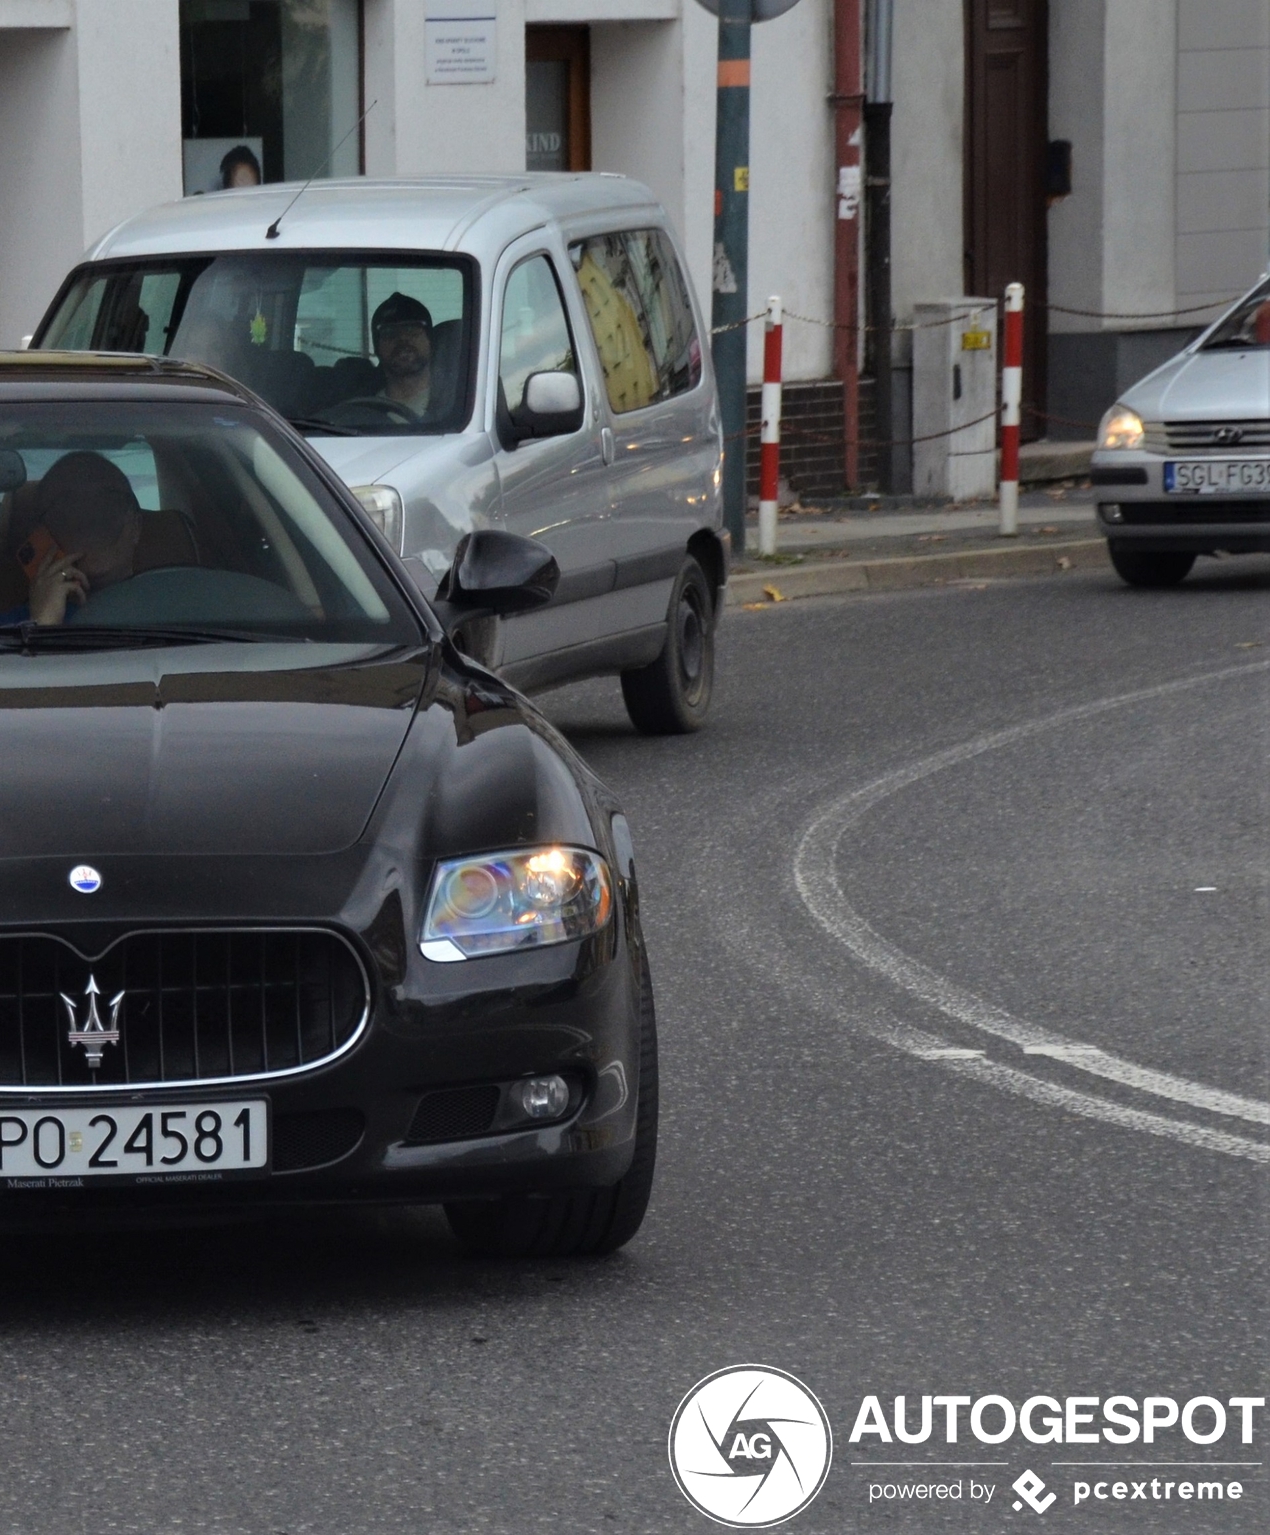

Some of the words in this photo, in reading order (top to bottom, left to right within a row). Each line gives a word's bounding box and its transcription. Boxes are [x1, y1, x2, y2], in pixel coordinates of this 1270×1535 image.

[1178, 465, 1219, 486] SGL
[88, 1107, 251, 1168] 24581
[7, 1178, 46, 1189] Maserati
